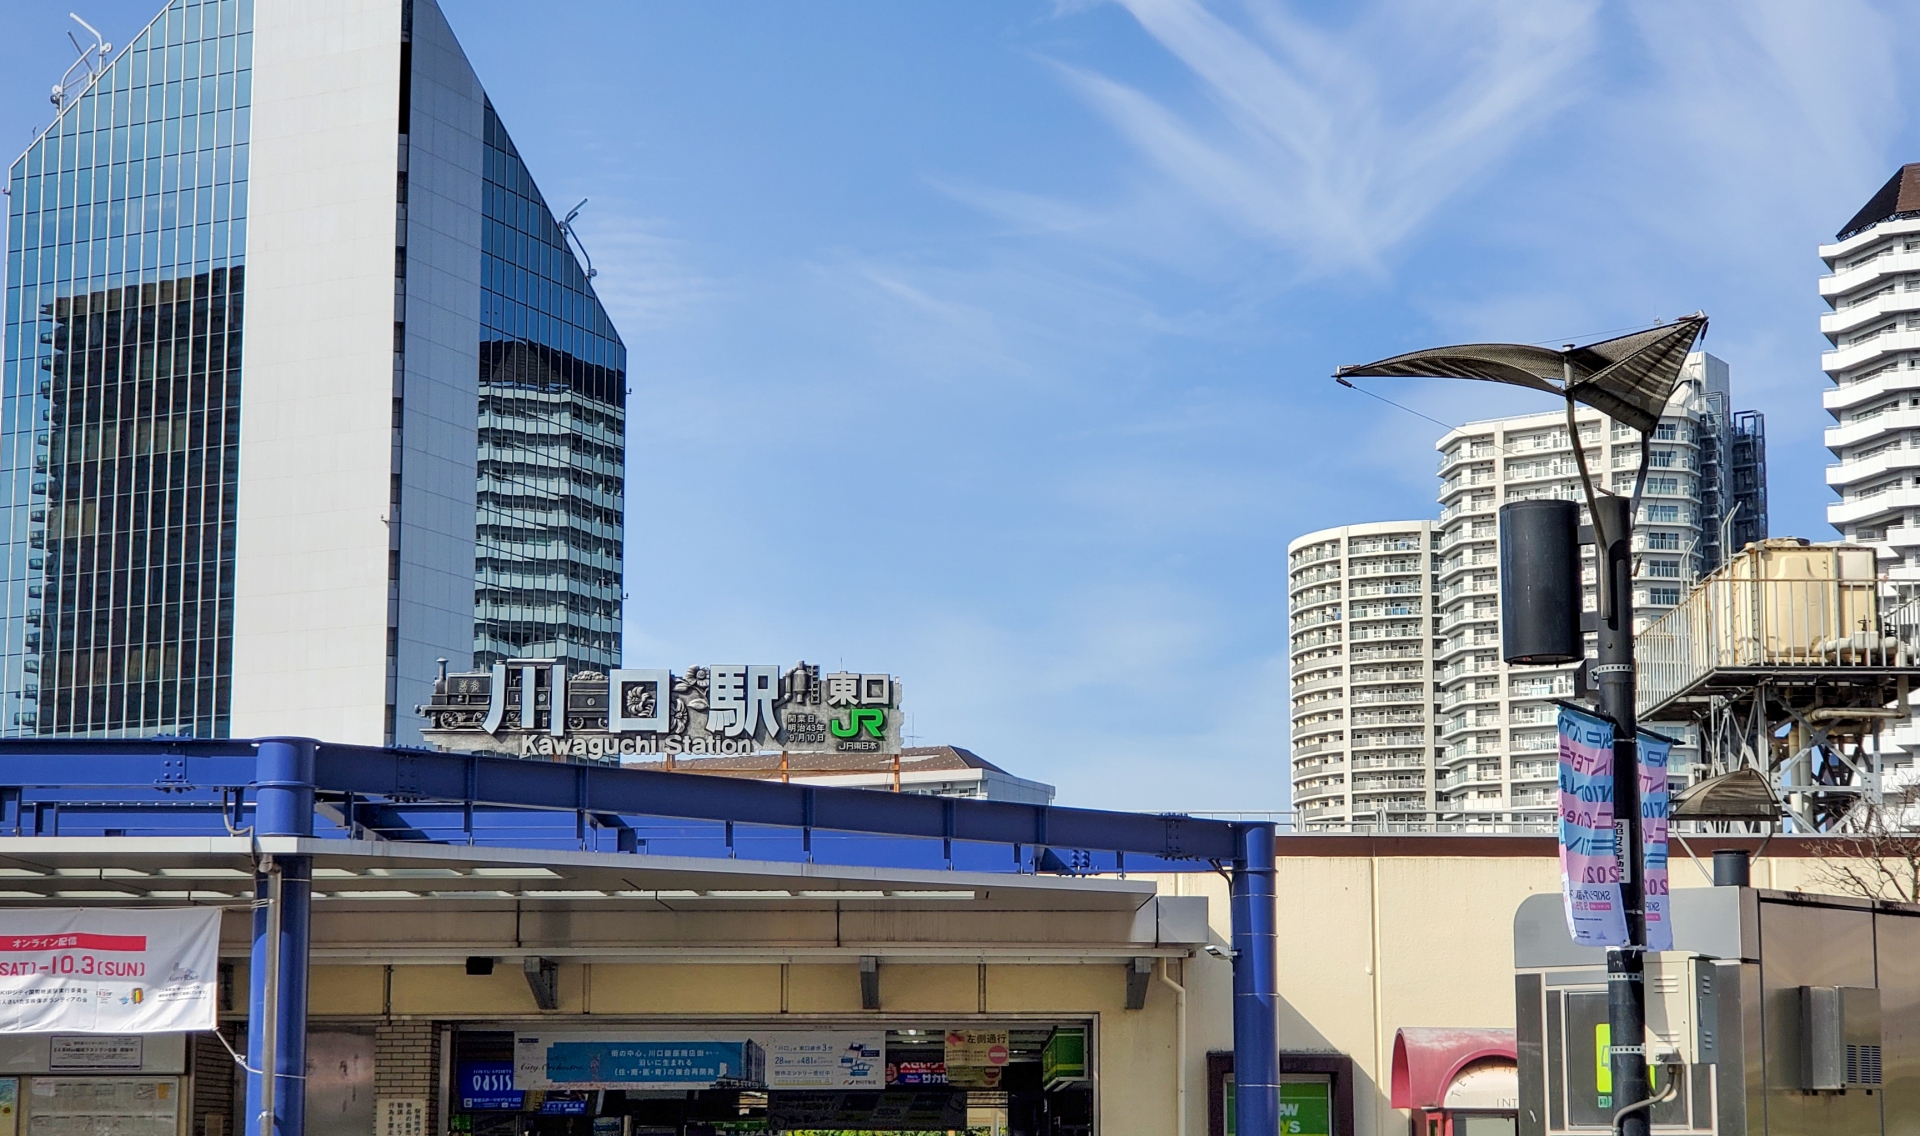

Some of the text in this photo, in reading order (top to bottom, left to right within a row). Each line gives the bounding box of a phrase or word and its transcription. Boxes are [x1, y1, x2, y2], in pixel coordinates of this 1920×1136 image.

[827, 671, 890, 706] 東口
[482, 664, 781, 740] 川口駅
[787, 714, 816, 724] 開業日
[831, 708, 884, 738] JR
[787, 724, 826, 733] 明治43年
[789, 733, 825, 743] 9月10日
[521, 734, 752, 760] Kawaguchi Station
[838, 742, 878, 751] JR東日本
[12, 936, 78, 949] オンライン配信
[966, 1034, 1007, 1044] 左側通行
[638, 1058, 693, 1067] 沿いに生まれる
[1451, 1063, 1519, 1098] TELEPH
